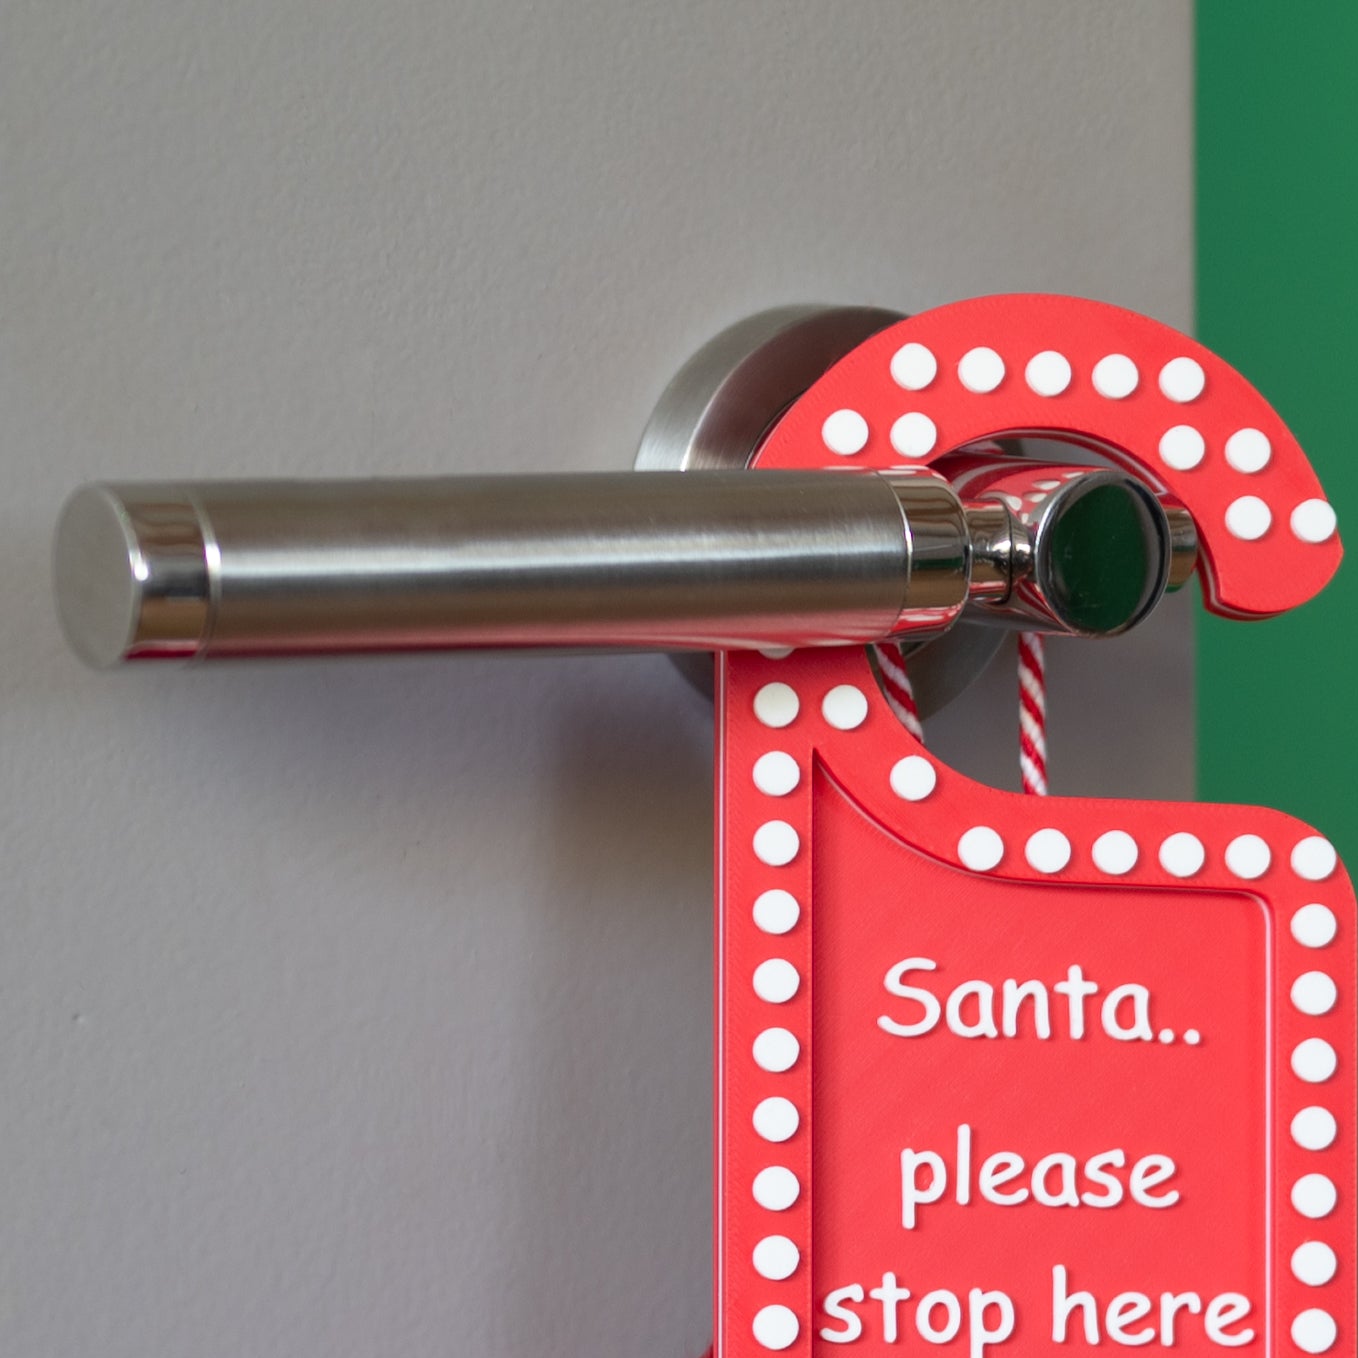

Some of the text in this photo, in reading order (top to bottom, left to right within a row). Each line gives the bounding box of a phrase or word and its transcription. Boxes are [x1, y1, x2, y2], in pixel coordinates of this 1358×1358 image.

[877, 957, 1201, 1045] Santa..
[900, 1123, 1181, 1230] please
[1051, 1264, 1256, 1347] here
